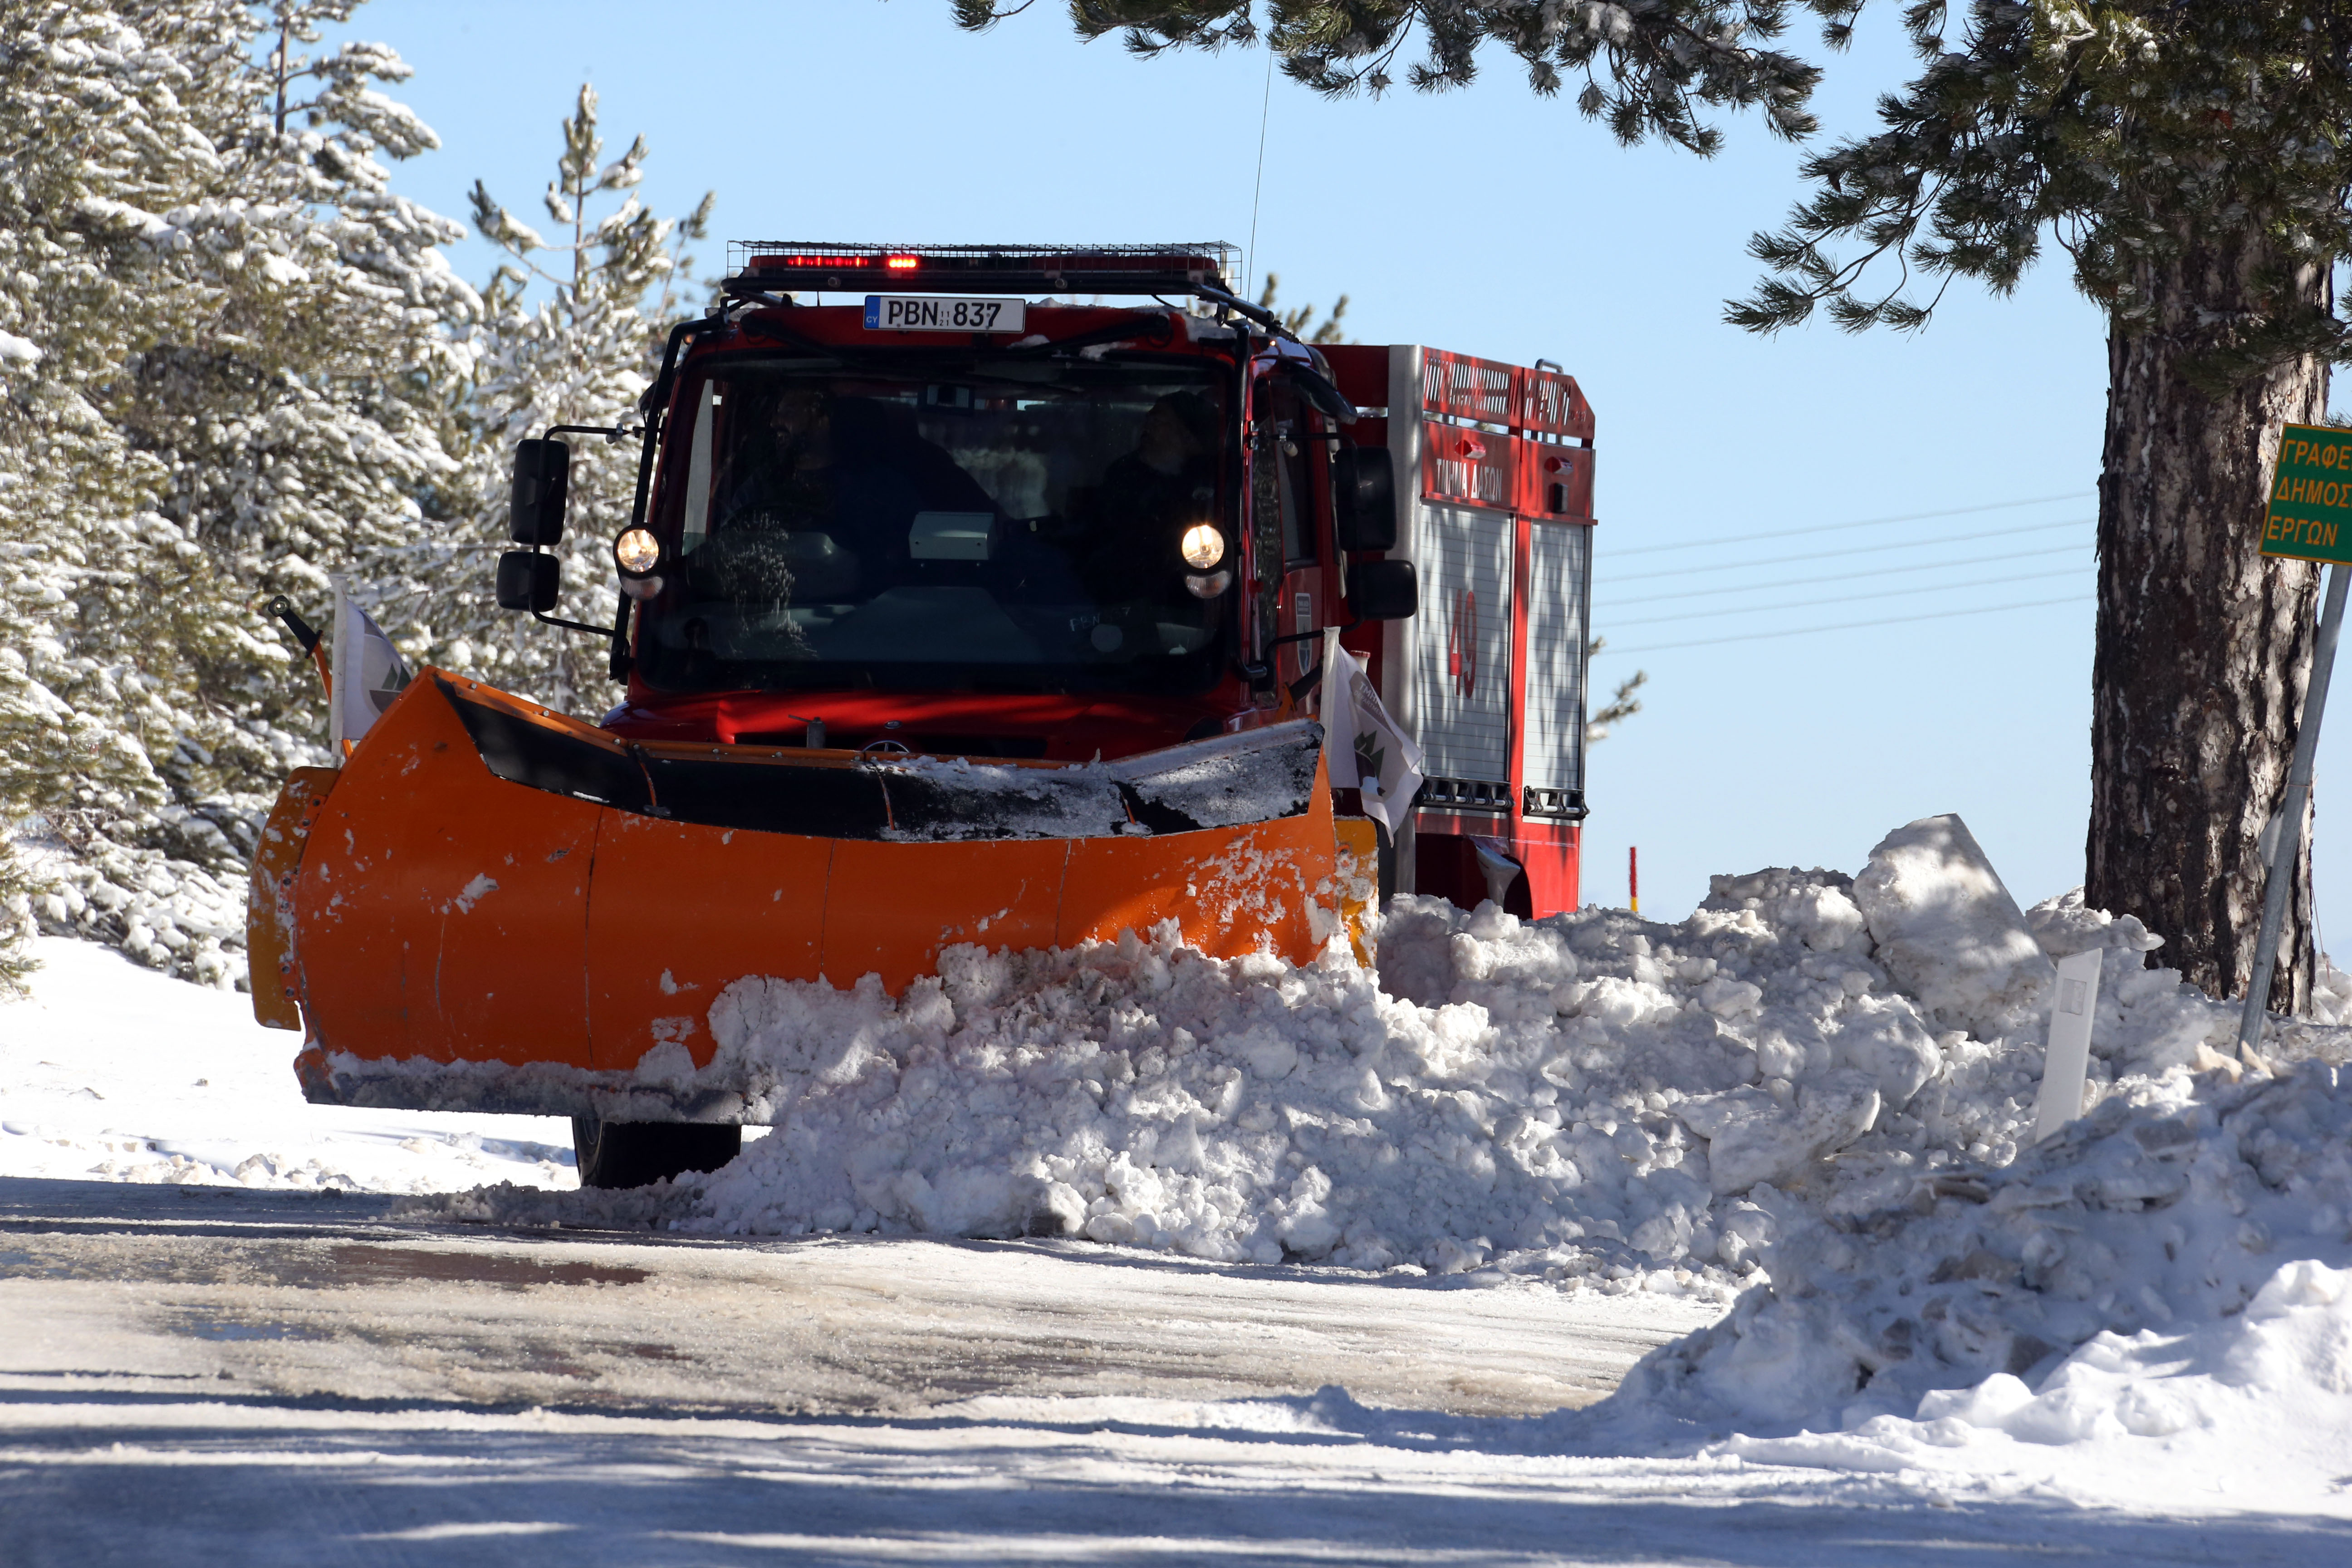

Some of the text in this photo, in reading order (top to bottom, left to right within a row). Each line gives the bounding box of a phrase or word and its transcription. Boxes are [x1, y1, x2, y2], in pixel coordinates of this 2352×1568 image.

[888, 300, 1001, 327] PBN 837
[2281, 439, 2352, 471] ΓΡΑΦΕ
[1436, 458, 1502, 502] ΤΜΗΜΑ ΔΑΣΩΝ
[2274, 476, 2352, 508] ΔΗΜΟΣ
[2267, 515, 2339, 547] ΕΡΓΩΝ
[1449, 588, 1477, 699] 49
